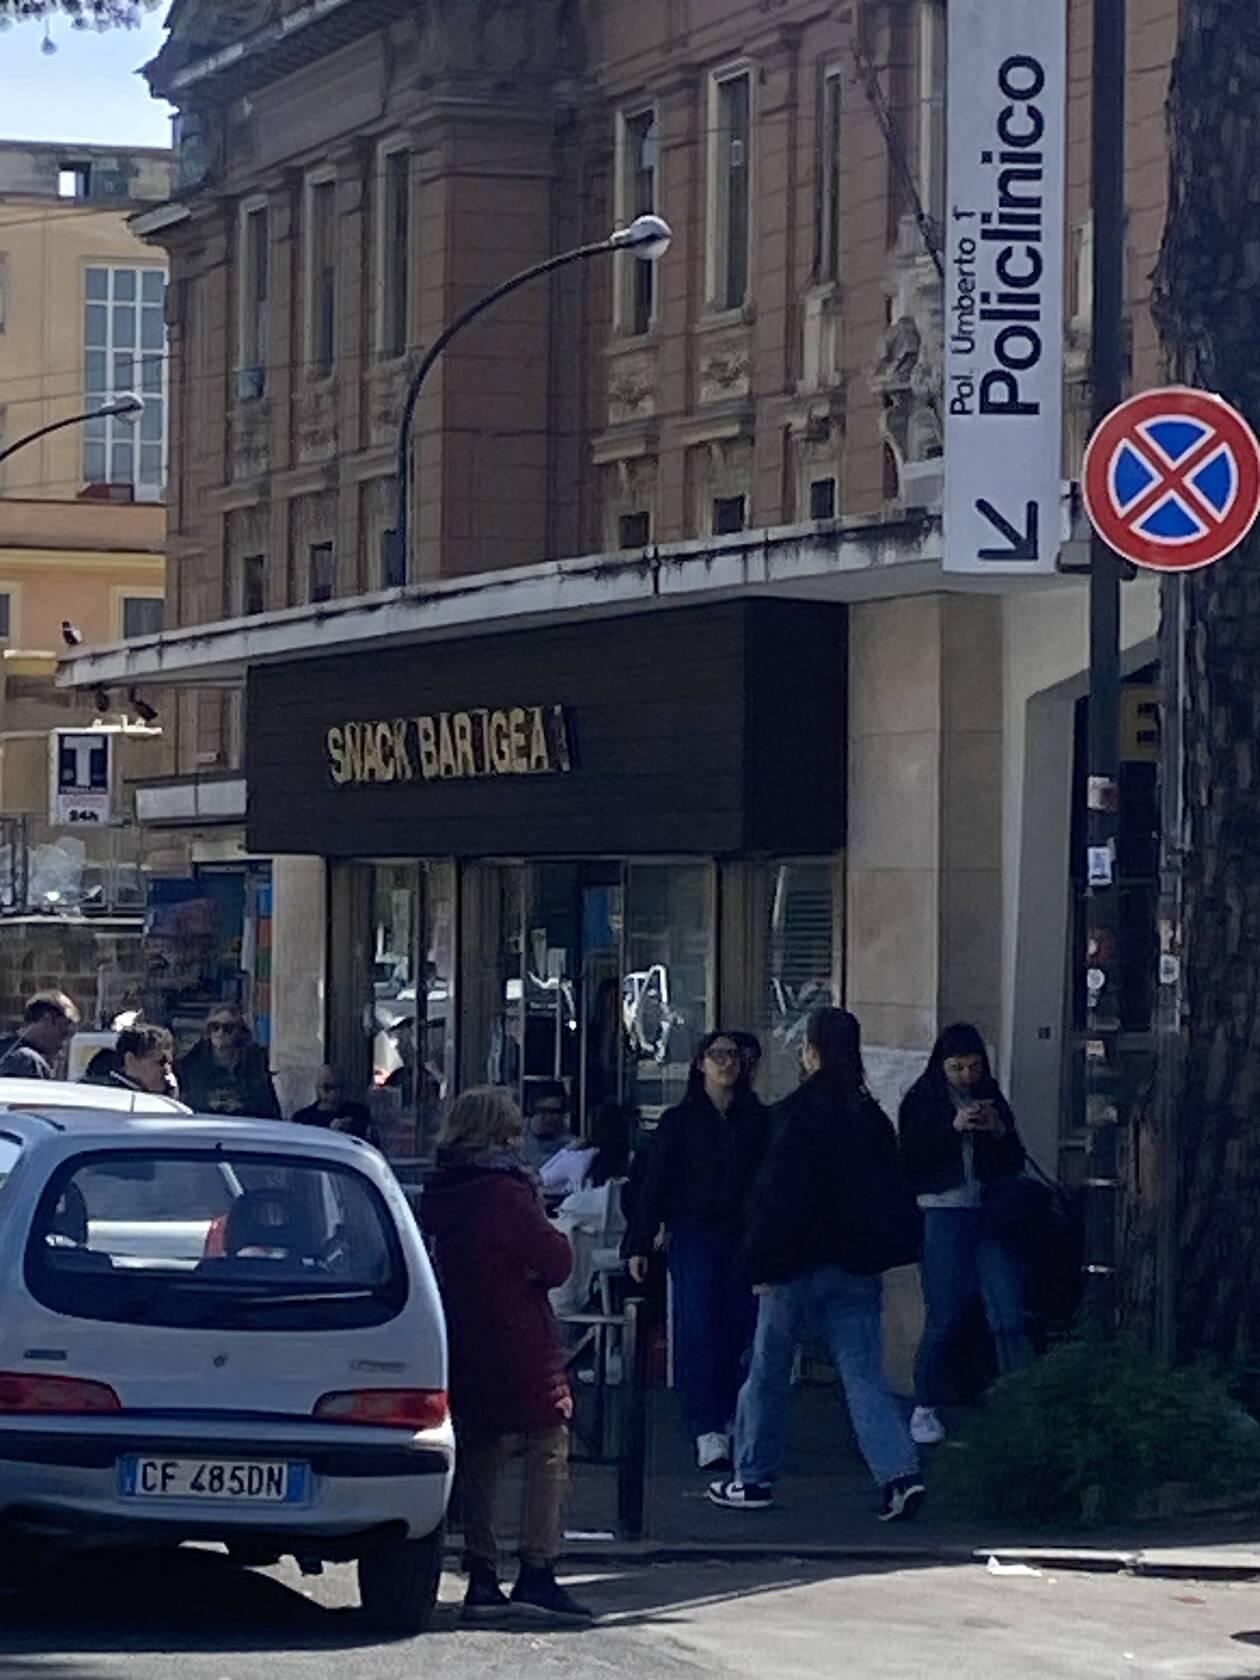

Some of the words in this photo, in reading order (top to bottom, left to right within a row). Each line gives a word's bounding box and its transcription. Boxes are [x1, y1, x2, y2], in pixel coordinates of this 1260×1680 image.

[979, 54, 1045, 415] Policlinico
[952, 237, 976, 355] Umberto
[950, 371, 975, 416] Pol.
[63, 736, 103, 785] T
[328, 719, 412, 783] SNACK
[418, 711, 476, 780] BAR
[475, 706, 550, 775] IGEA
[142, 1462, 179, 1493] CF
[190, 1464, 284, 1497] 485DN
